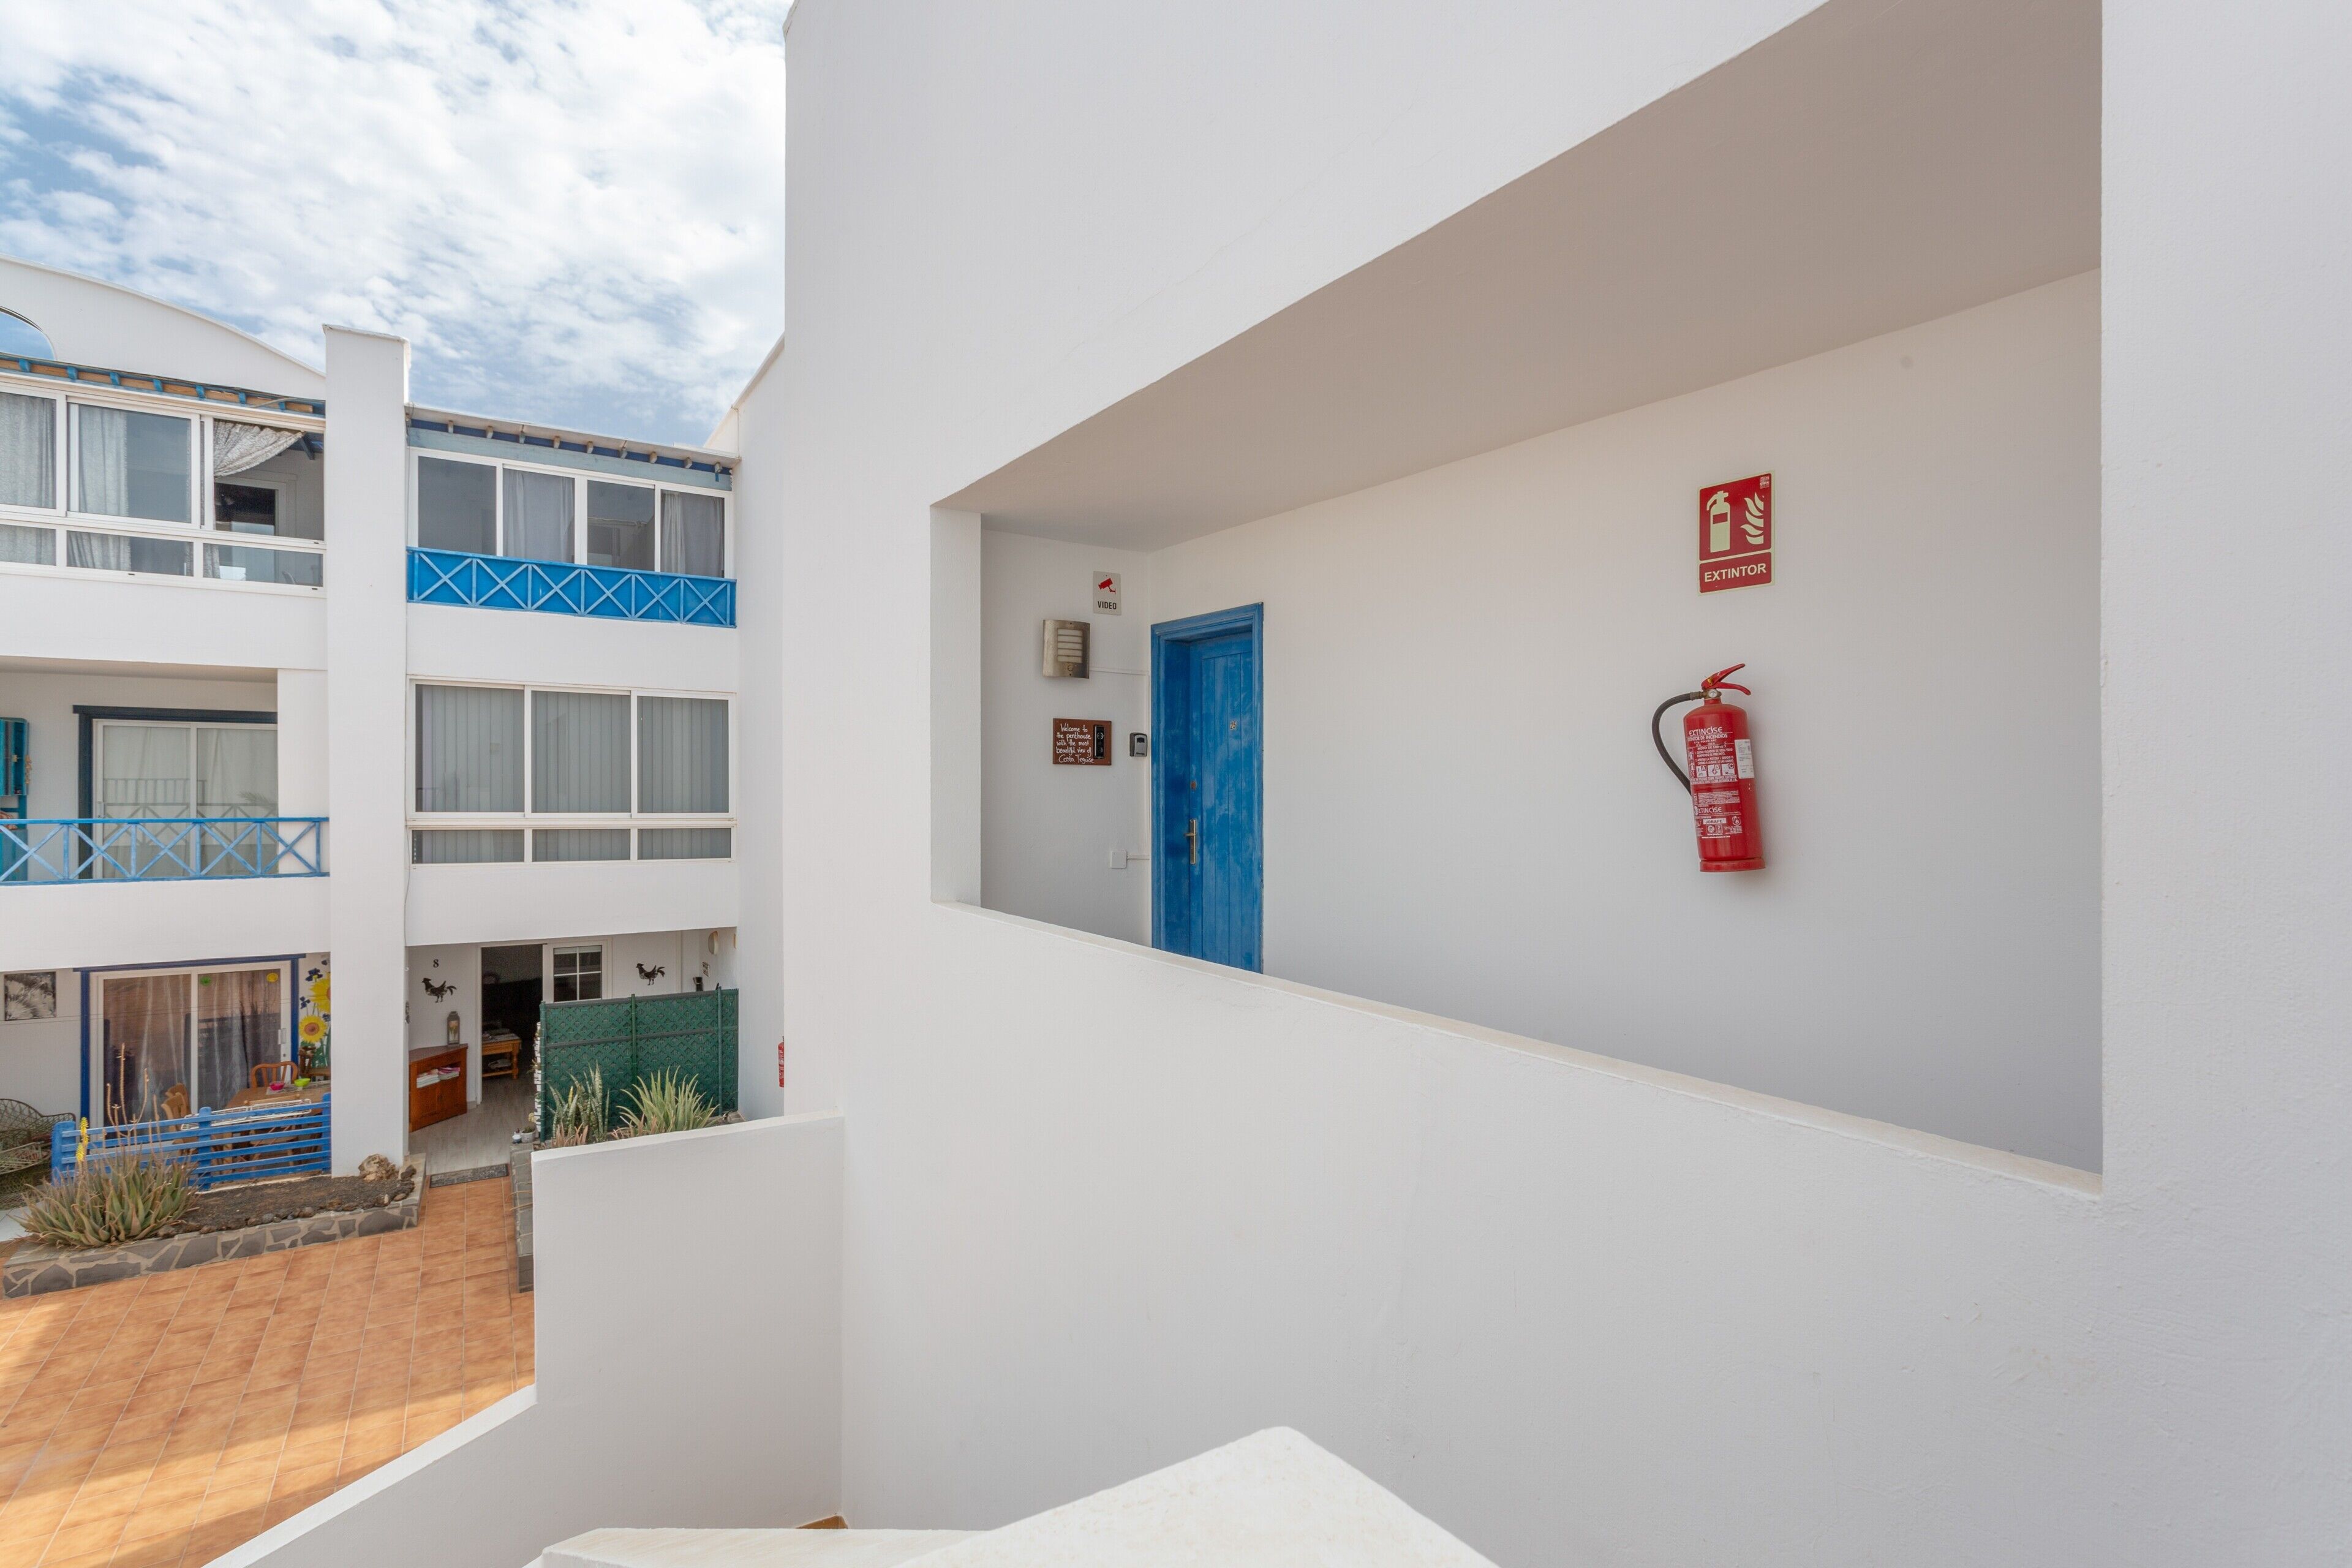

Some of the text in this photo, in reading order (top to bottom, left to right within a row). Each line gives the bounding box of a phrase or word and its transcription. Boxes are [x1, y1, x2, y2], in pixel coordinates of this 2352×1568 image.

[1705, 563, 1766, 582] EXTINTOR
[1098, 601, 1117, 609] VIDEO
[1060, 723, 1080, 732] Welcome
[1066, 733, 1091, 742] penthouse
[1087, 747, 1092, 756] of
[1059, 754, 1095, 764] Costa Teguise
[433, 959, 439, 968] 8
